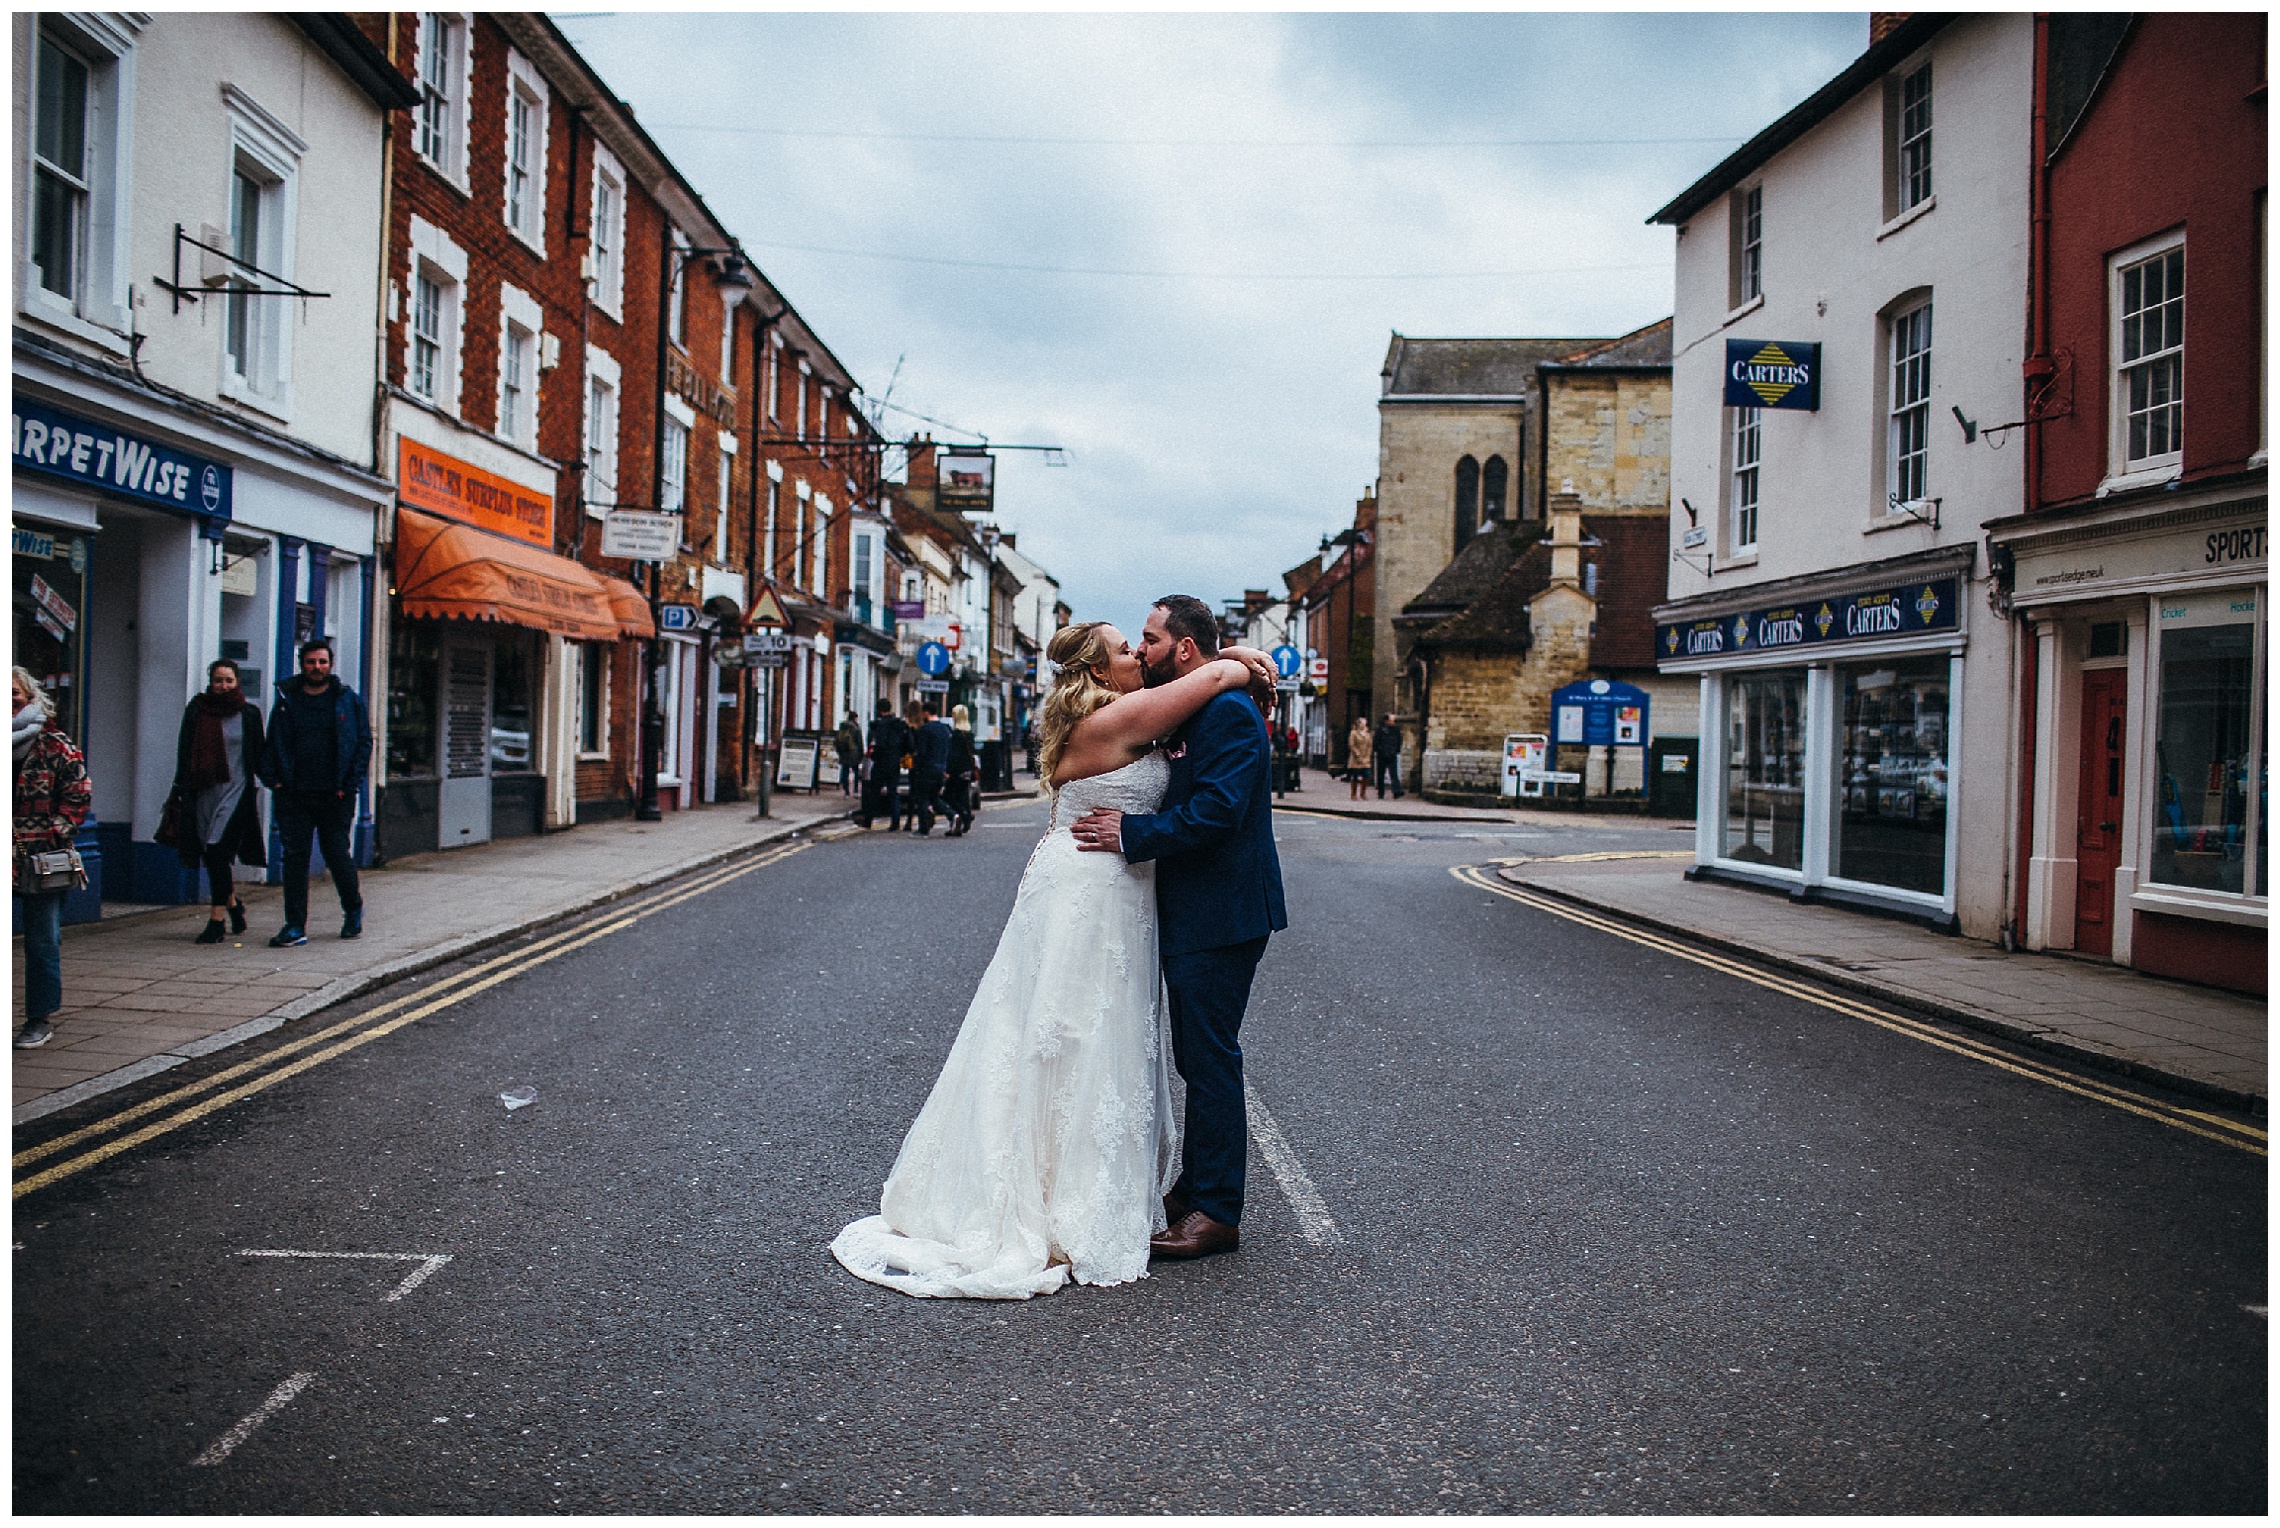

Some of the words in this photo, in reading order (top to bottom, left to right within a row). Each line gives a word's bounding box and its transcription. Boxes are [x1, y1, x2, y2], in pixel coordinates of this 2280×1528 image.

[1732, 359, 1809, 386] CARTERS
[1847, 598, 1900, 636] CARTERS
[2161, 607, 2187, 619] Cricket
[1687, 624, 1723, 655] CARTERS
[1760, 612, 1803, 646] CARTERS
